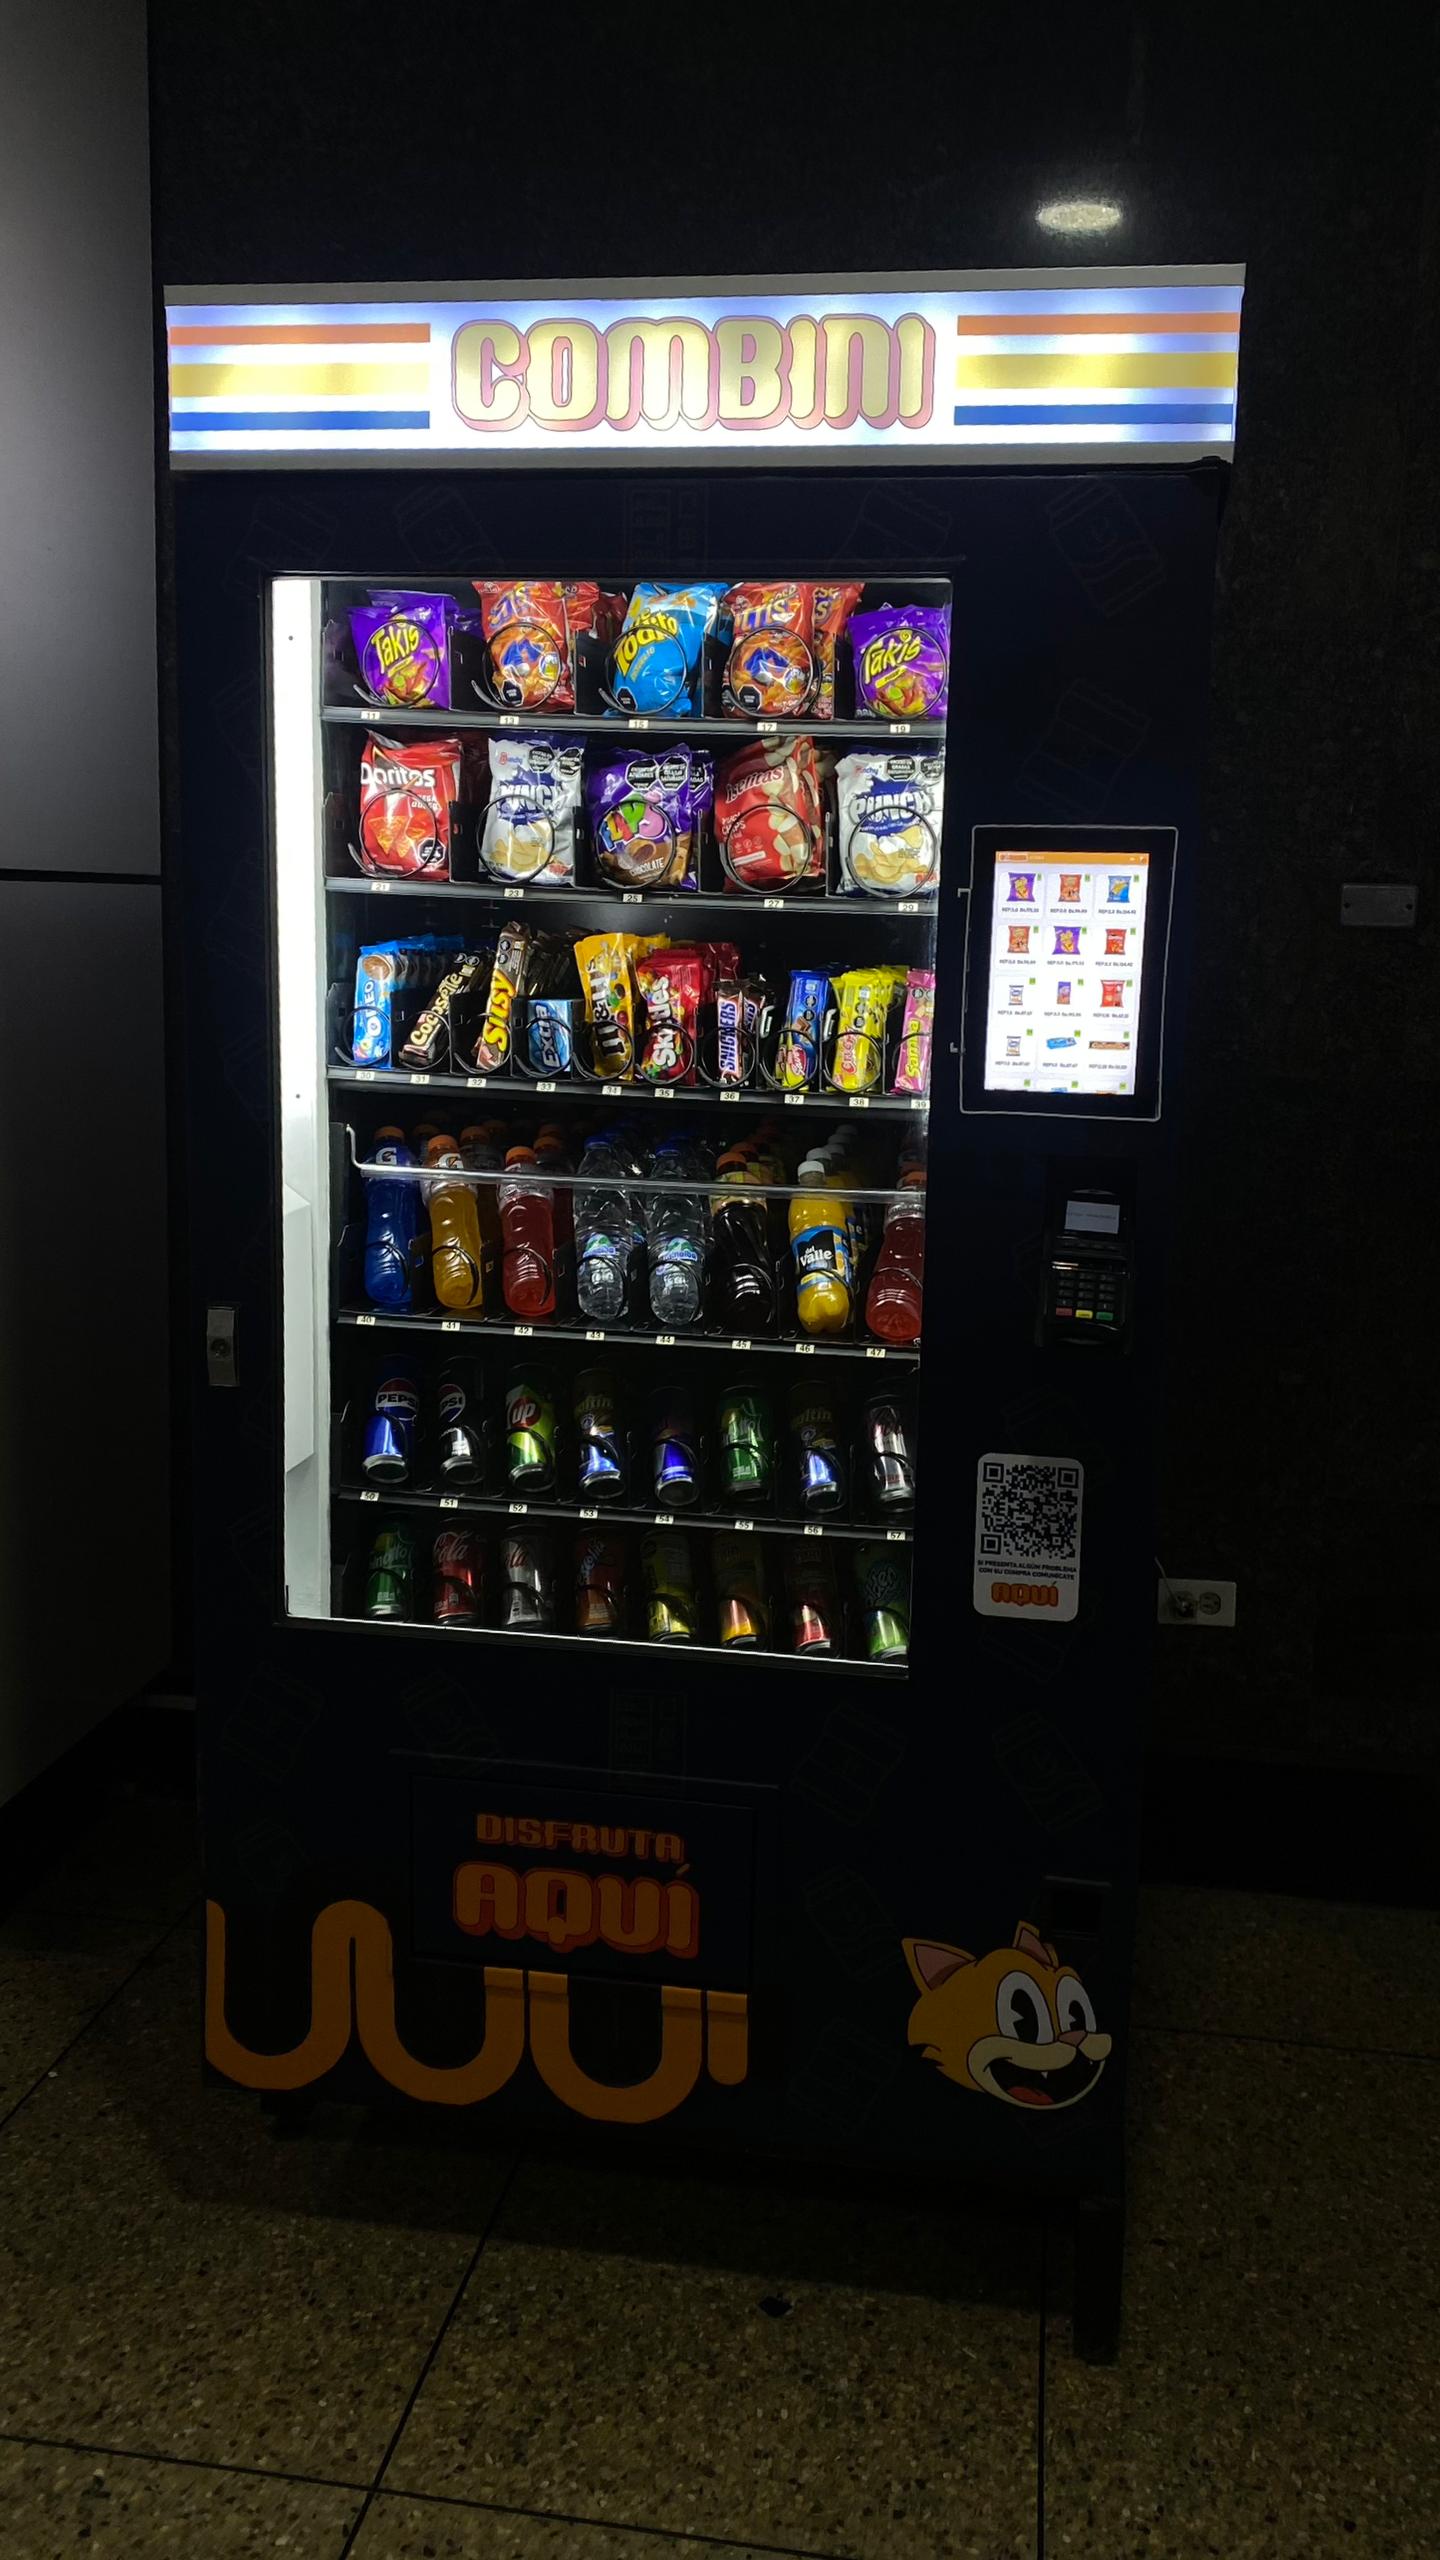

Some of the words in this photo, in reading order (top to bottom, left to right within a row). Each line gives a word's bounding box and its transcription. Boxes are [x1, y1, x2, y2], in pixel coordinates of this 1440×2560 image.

[450, 313, 935, 431] COMBINI
[371, 618, 421, 675] Takis
[861, 631, 921, 684] Takis
[360, 762, 436, 788] Doritos
[364, 980, 382, 1038] OREO
[410, 973, 464, 1046] Cocosette
[717, 1001, 737, 1073] SNICKERS
[800, 1249, 833, 1268] Valle
[378, 1393, 417, 1407] PEPS
[985, 1560, 1017, 1568] PRESENTA
[1041, 1564, 1077, 1573] PROBLEMA
[1003, 1569, 1031, 1577] COMPRA
[991, 1581, 1059, 1607] AQUÍ
[476, 1813, 685, 1864] DISFRUTA
[453, 1860, 700, 1959] AQUÍ
